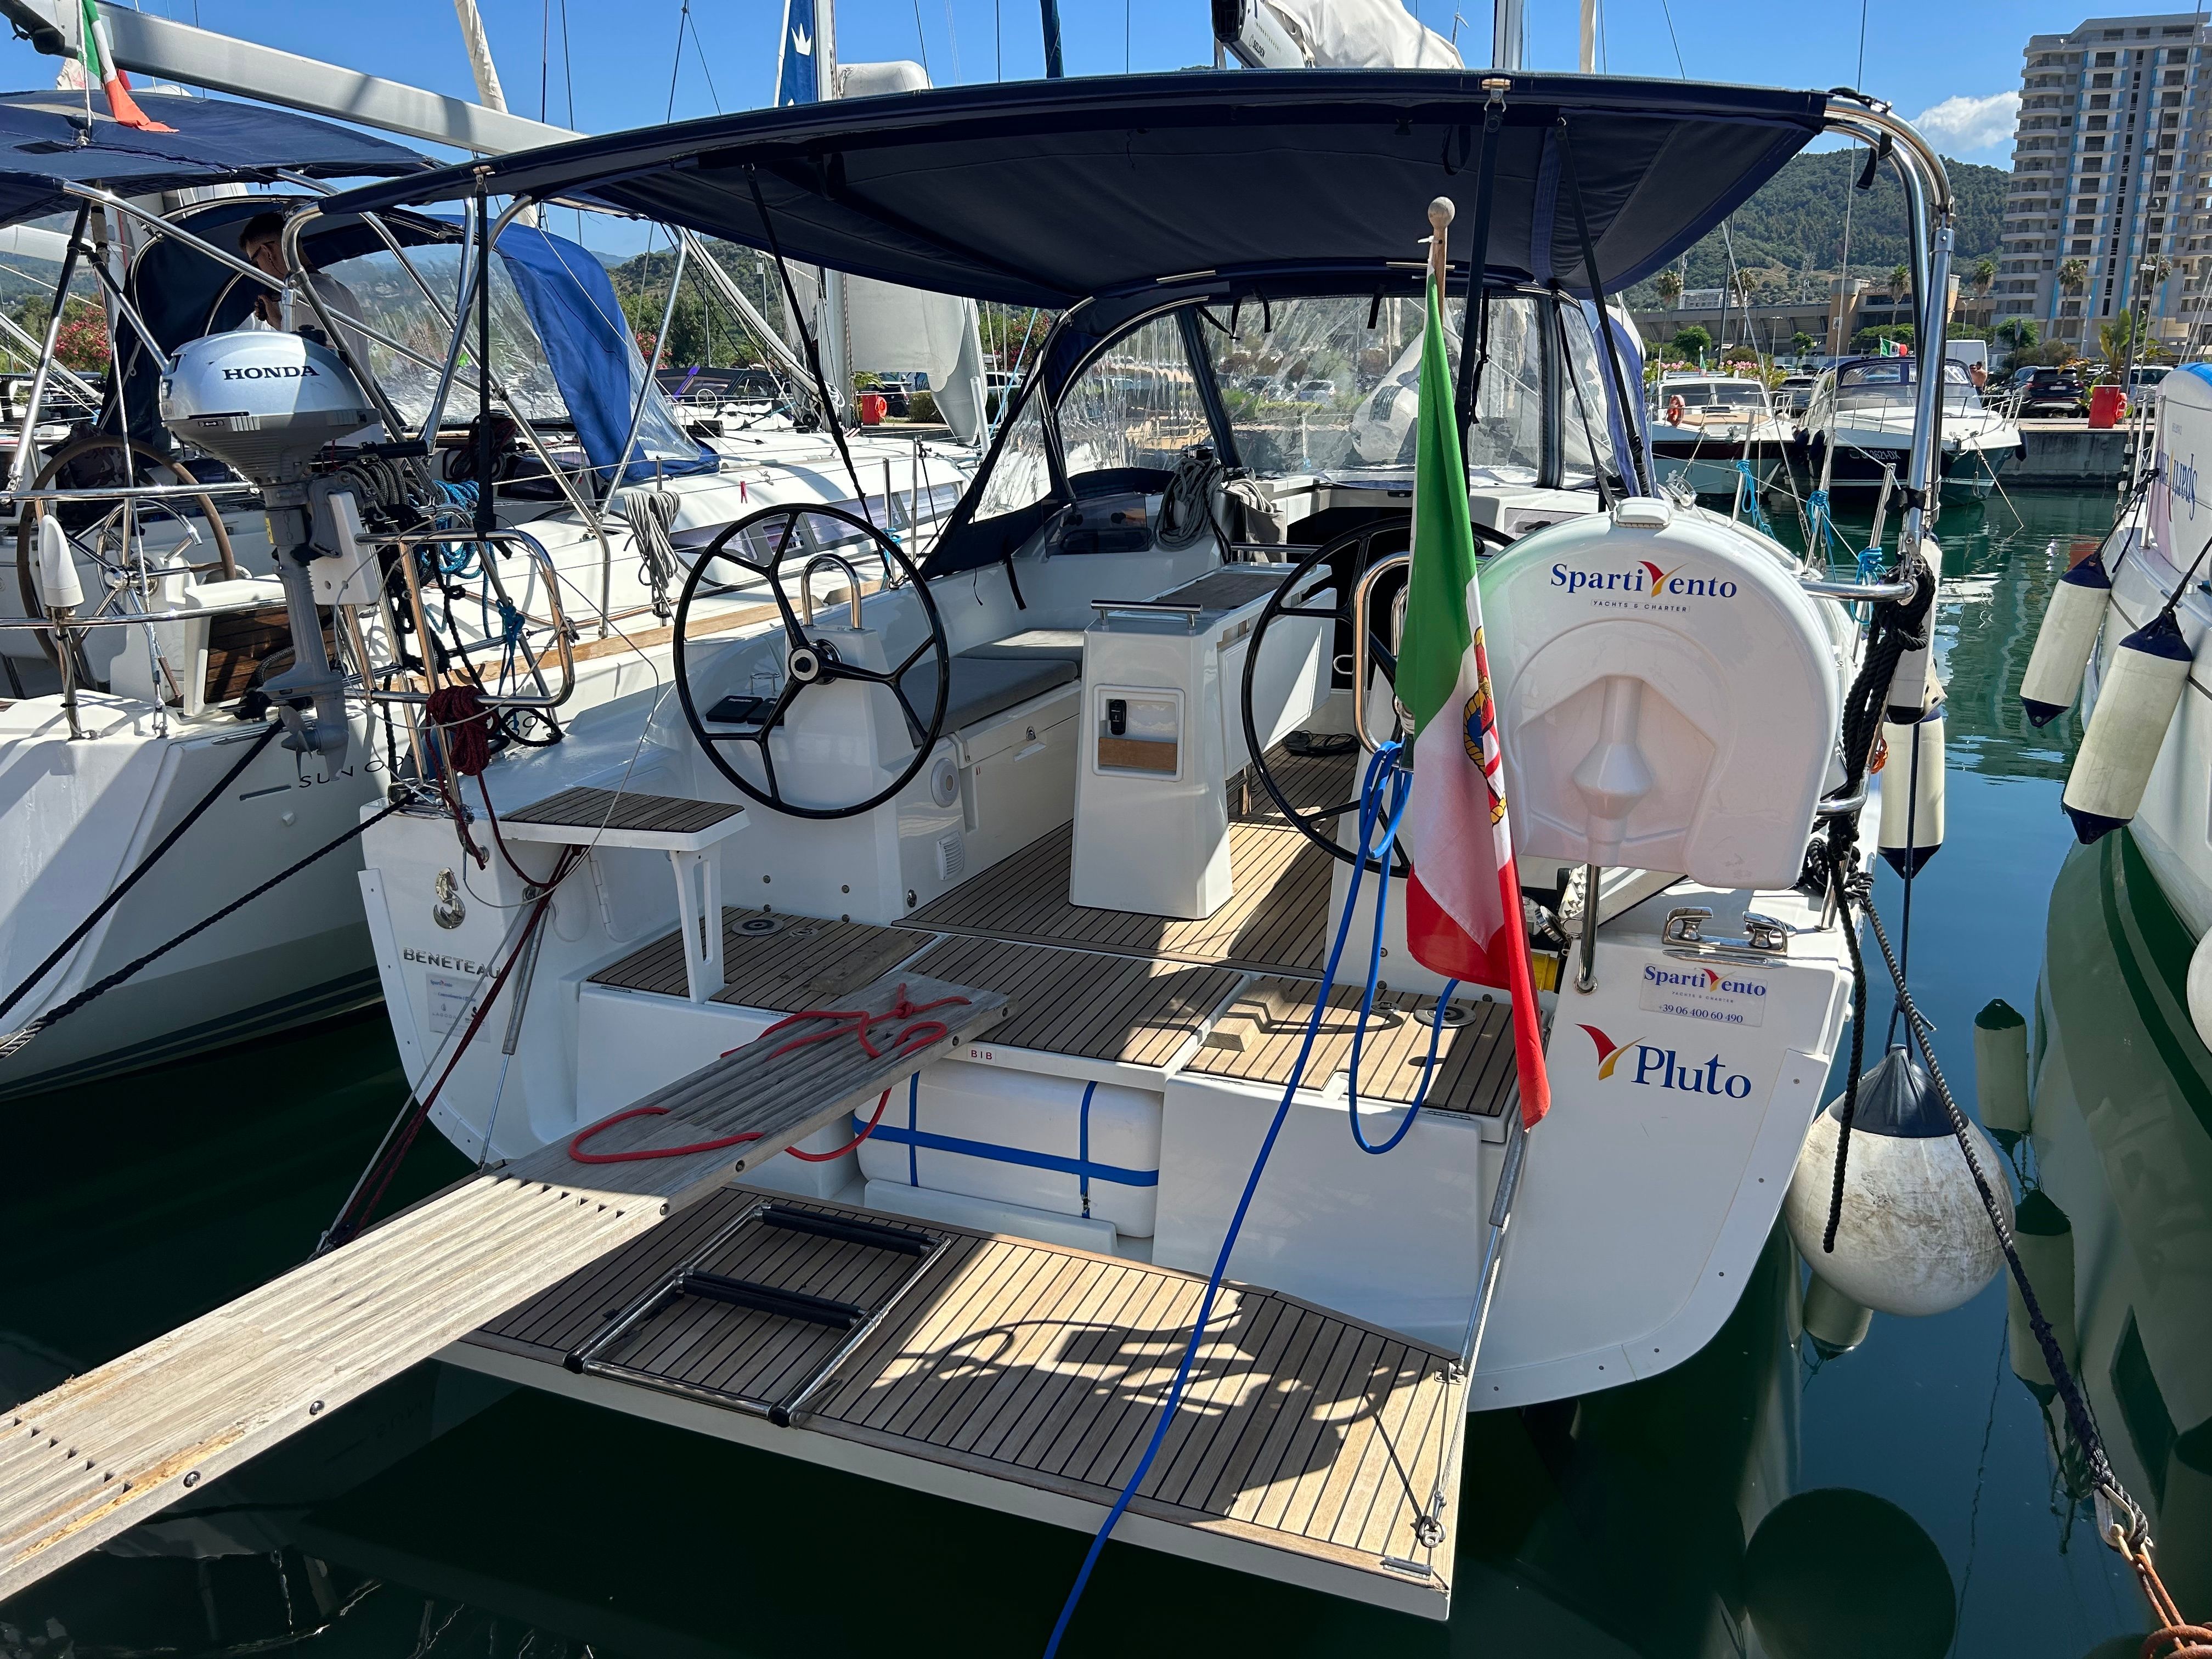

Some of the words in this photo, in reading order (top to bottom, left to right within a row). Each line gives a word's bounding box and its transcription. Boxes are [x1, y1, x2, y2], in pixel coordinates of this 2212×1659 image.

[222, 365, 320, 380] HONDA
[1550, 560, 1737, 598] SpartiVento
[403, 947, 501, 979] BENETEAU
[1644, 966, 1766, 996] SpartiVento
[1675, 1006, 1688, 1015] 06
[1690, 1009, 1709, 1018] 400
[1711, 1012, 1723, 1020] 60
[1725, 1014, 1743, 1023] 490
[971, 1049, 992, 1060] BIB
[1630, 1045, 1752, 1099] Pluto
